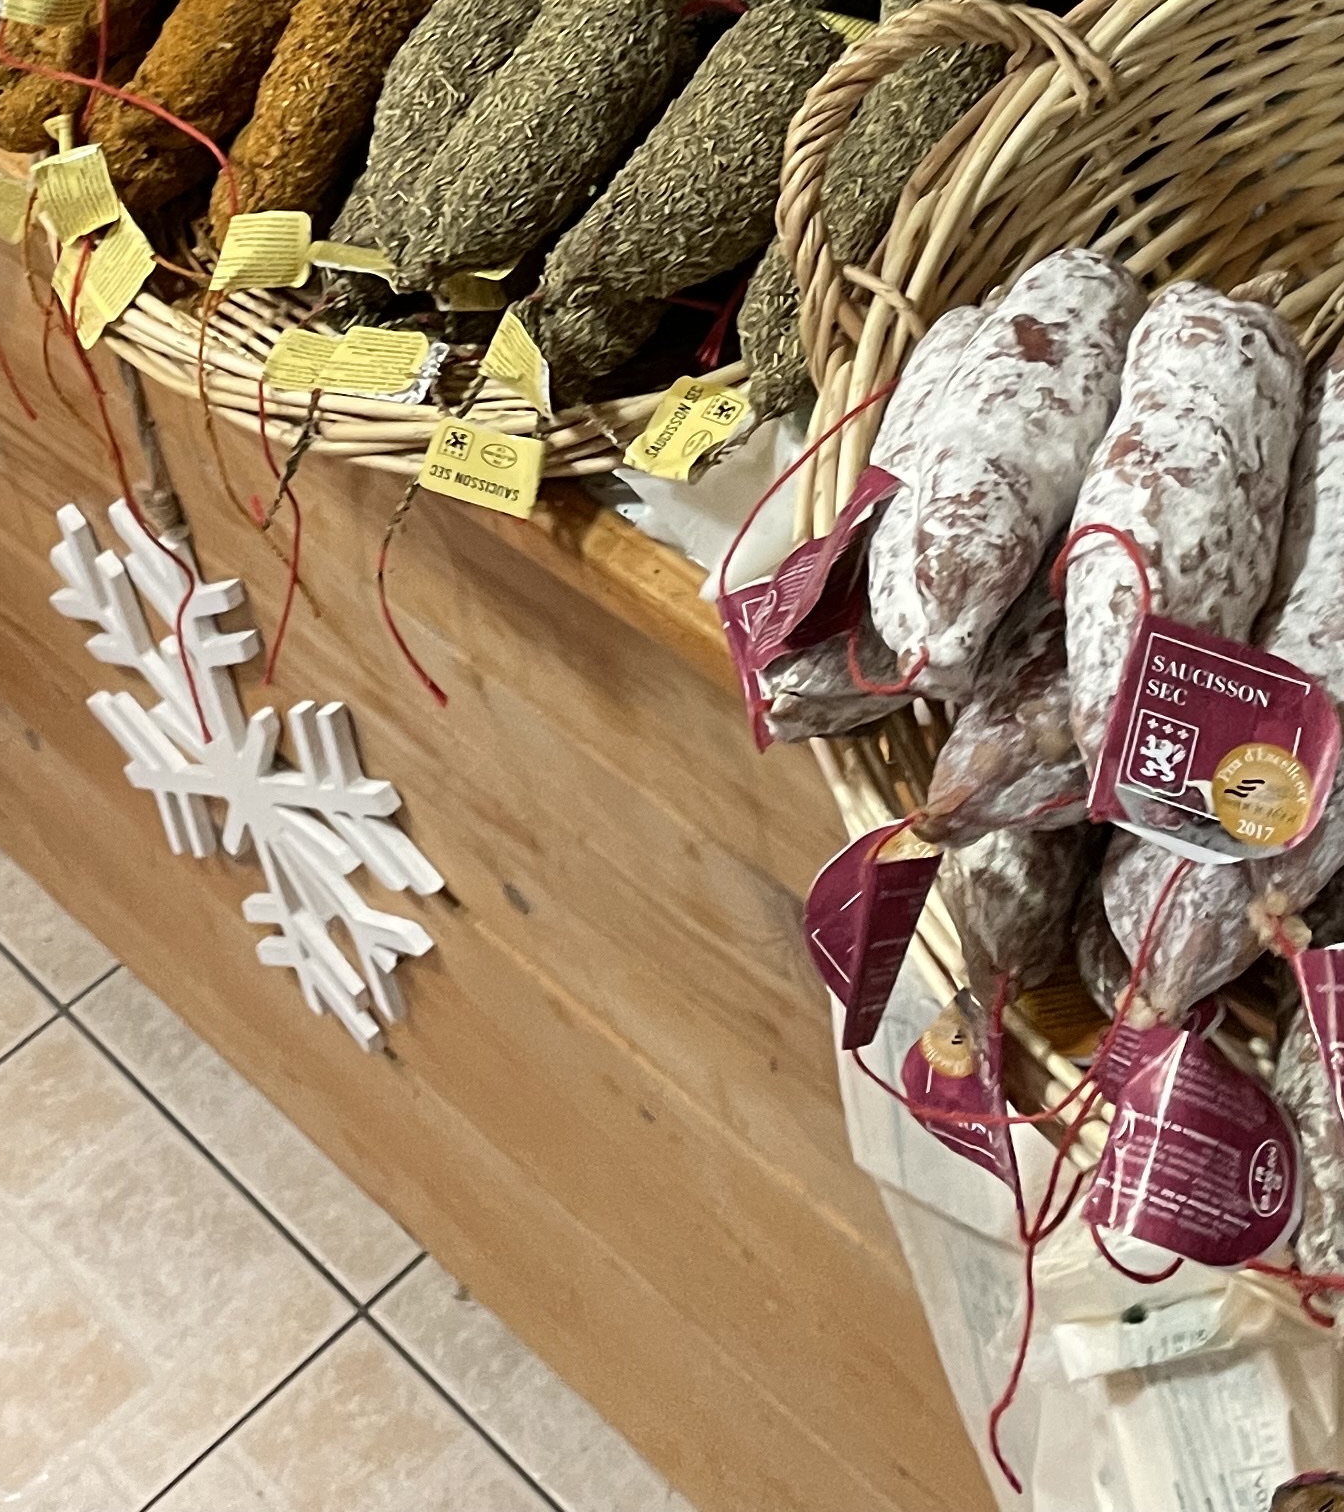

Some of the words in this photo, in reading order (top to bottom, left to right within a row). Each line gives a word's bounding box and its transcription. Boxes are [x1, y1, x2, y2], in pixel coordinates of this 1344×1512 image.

[644, 402, 692, 459] SAUCISSON
[429, 464, 453, 480] SEC
[453, 471, 521, 502] SAUCISSON
[1145, 678, 1189, 707] SEC
[1150, 654, 1273, 708] SAUCISSON
[1235, 818, 1276, 842] 2017
